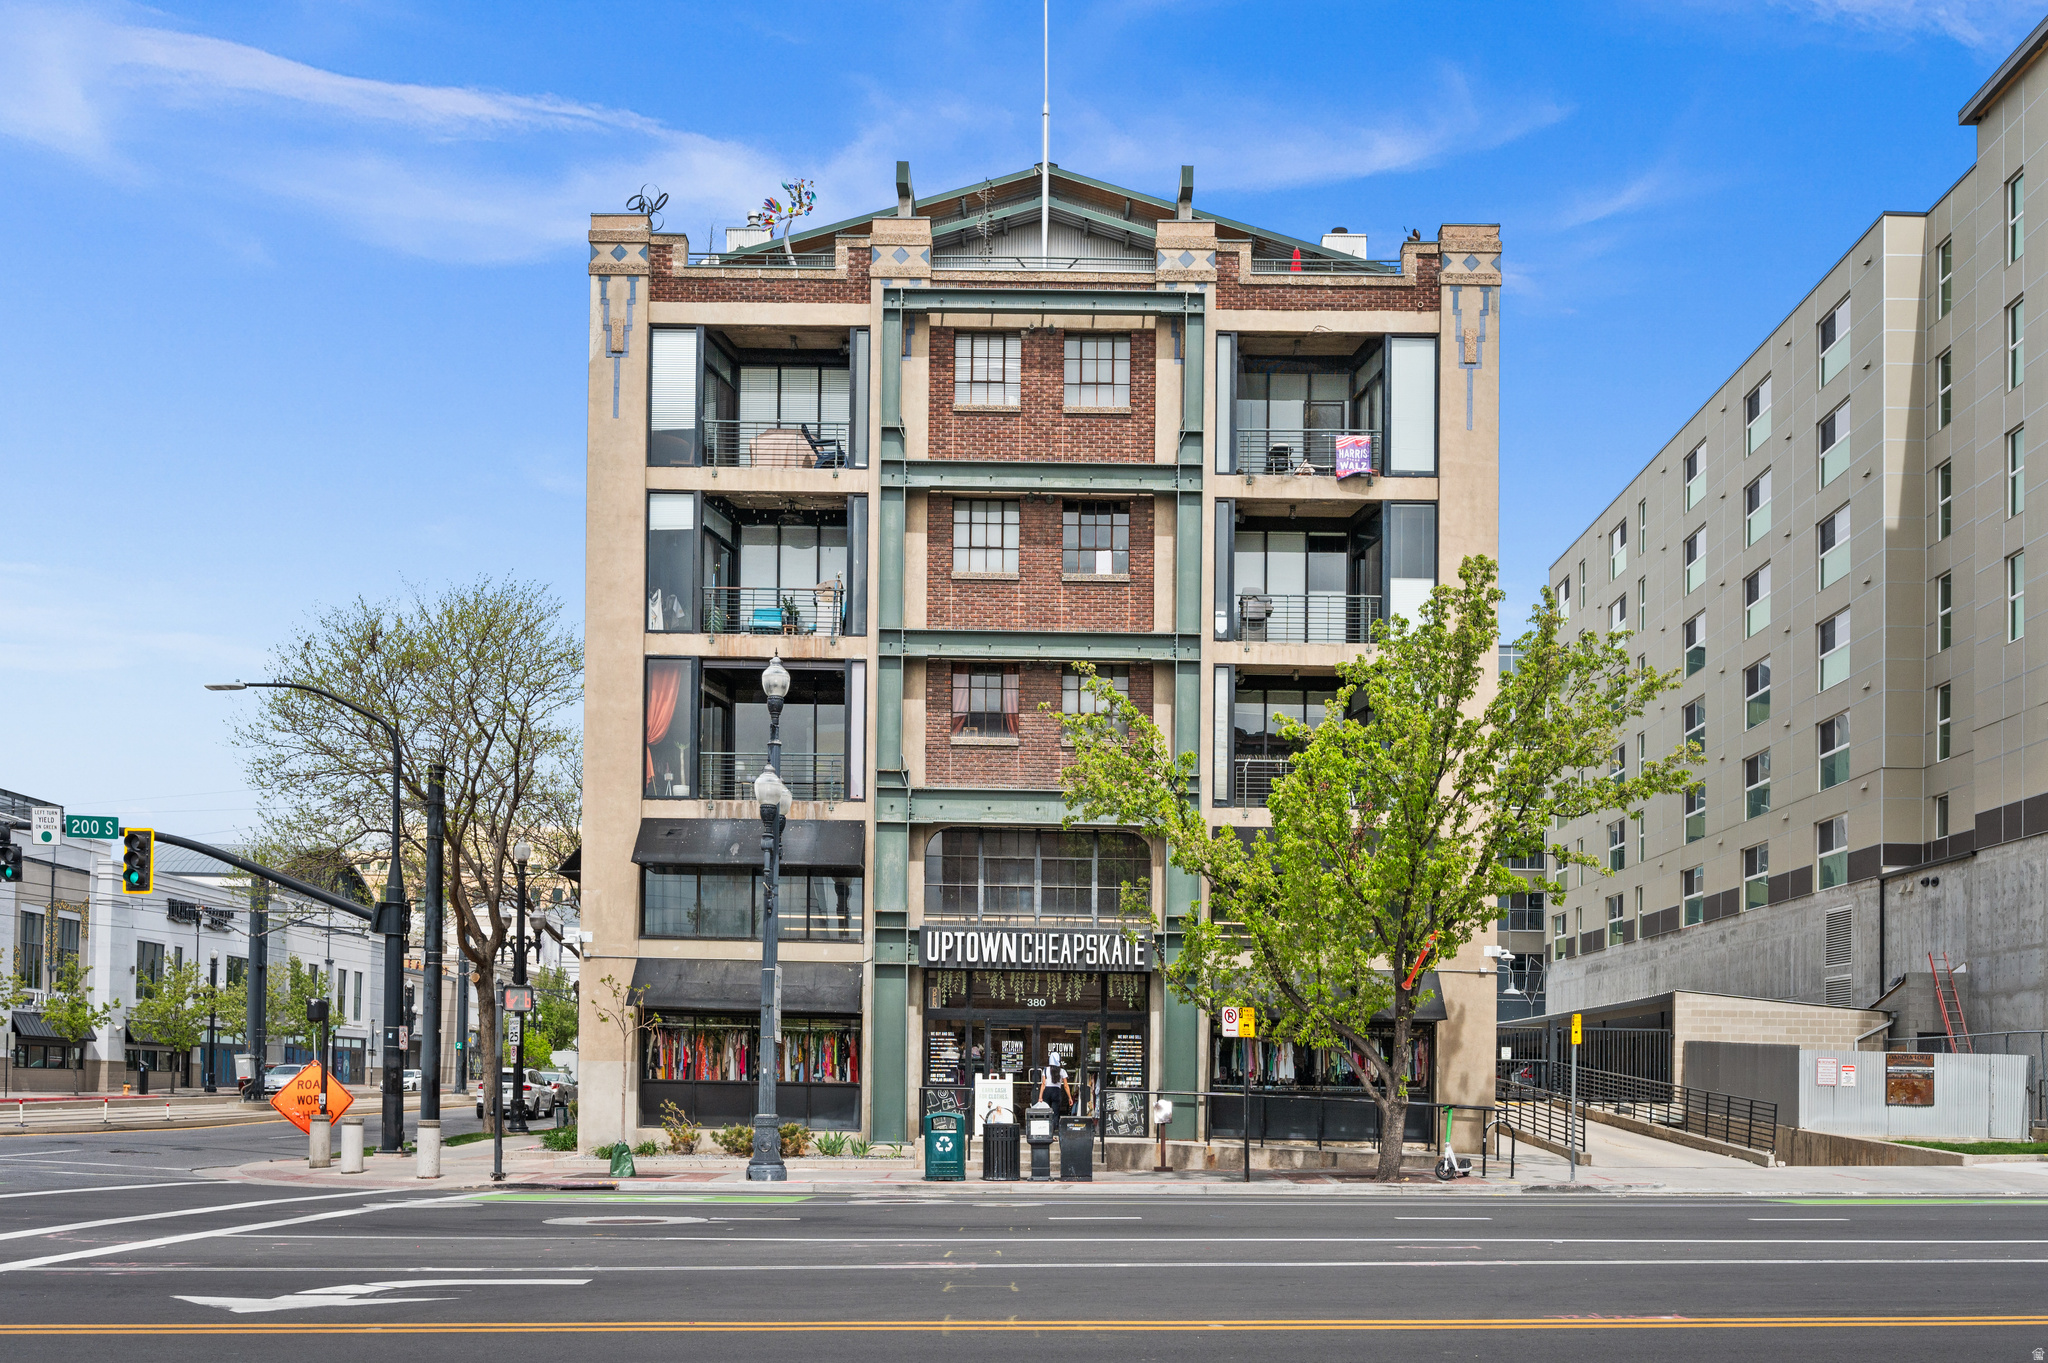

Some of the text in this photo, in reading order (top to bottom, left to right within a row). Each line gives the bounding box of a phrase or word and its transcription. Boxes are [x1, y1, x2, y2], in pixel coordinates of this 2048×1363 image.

[1338, 449, 1368, 459] HARRIS
[1340, 461, 1367, 470] WALZ
[38, 816, 55, 824] YIELD
[71, 819, 113, 836] 200 S
[927, 931, 1145, 965] UPTOWN CHEAPSKATE
[1027, 998, 1046, 1007] 380
[509, 1031, 519, 1042] 25
[1048, 1043, 1074, 1052] UPTOWN
[297, 1080, 321, 1090] ROA
[297, 1095, 320, 1105] WOR
